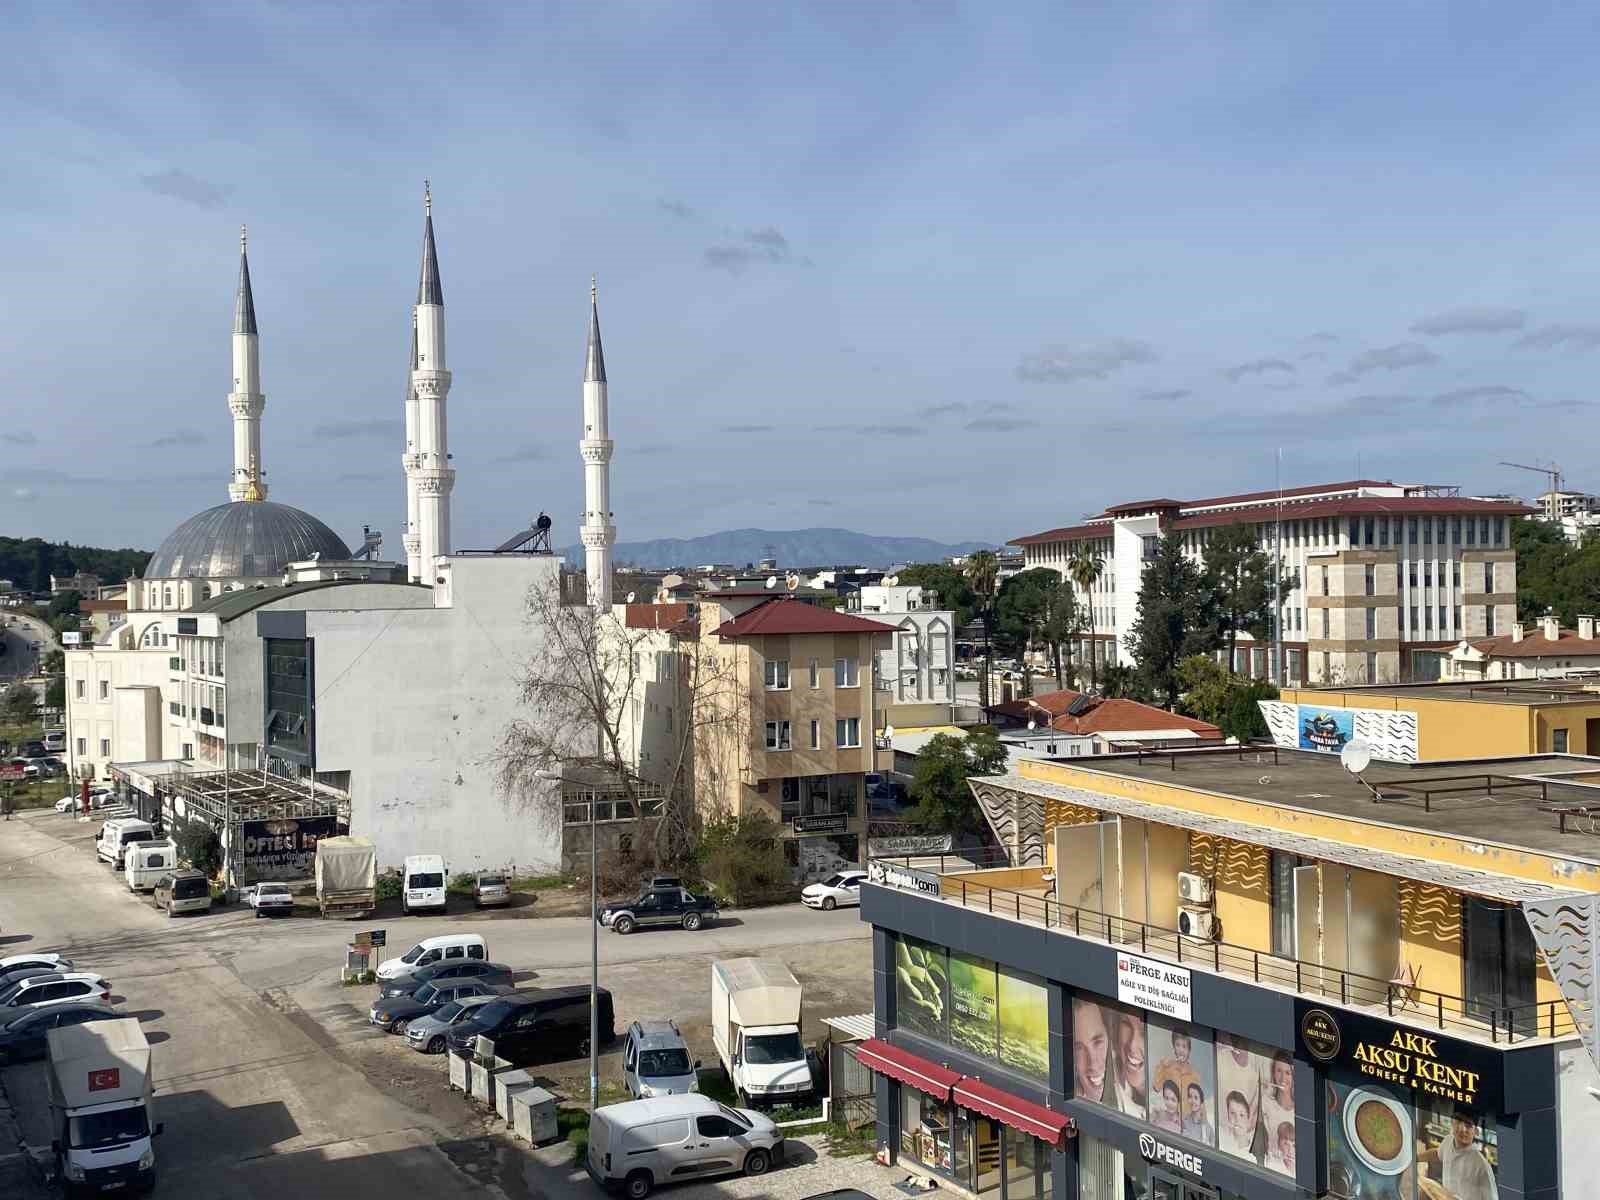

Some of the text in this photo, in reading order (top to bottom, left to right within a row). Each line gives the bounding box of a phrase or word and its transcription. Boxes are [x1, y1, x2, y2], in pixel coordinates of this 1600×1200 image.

[1130, 963, 1189, 987] PERGE AKSU
[1137, 983, 1147, 992] VE
[1390, 1030, 1438, 1058] AKK
[1353, 1041, 1480, 1093] AKSU KENT
[1424, 1082, 1473, 1104] KATMER
[1156, 1142, 1203, 1177] PERGE
